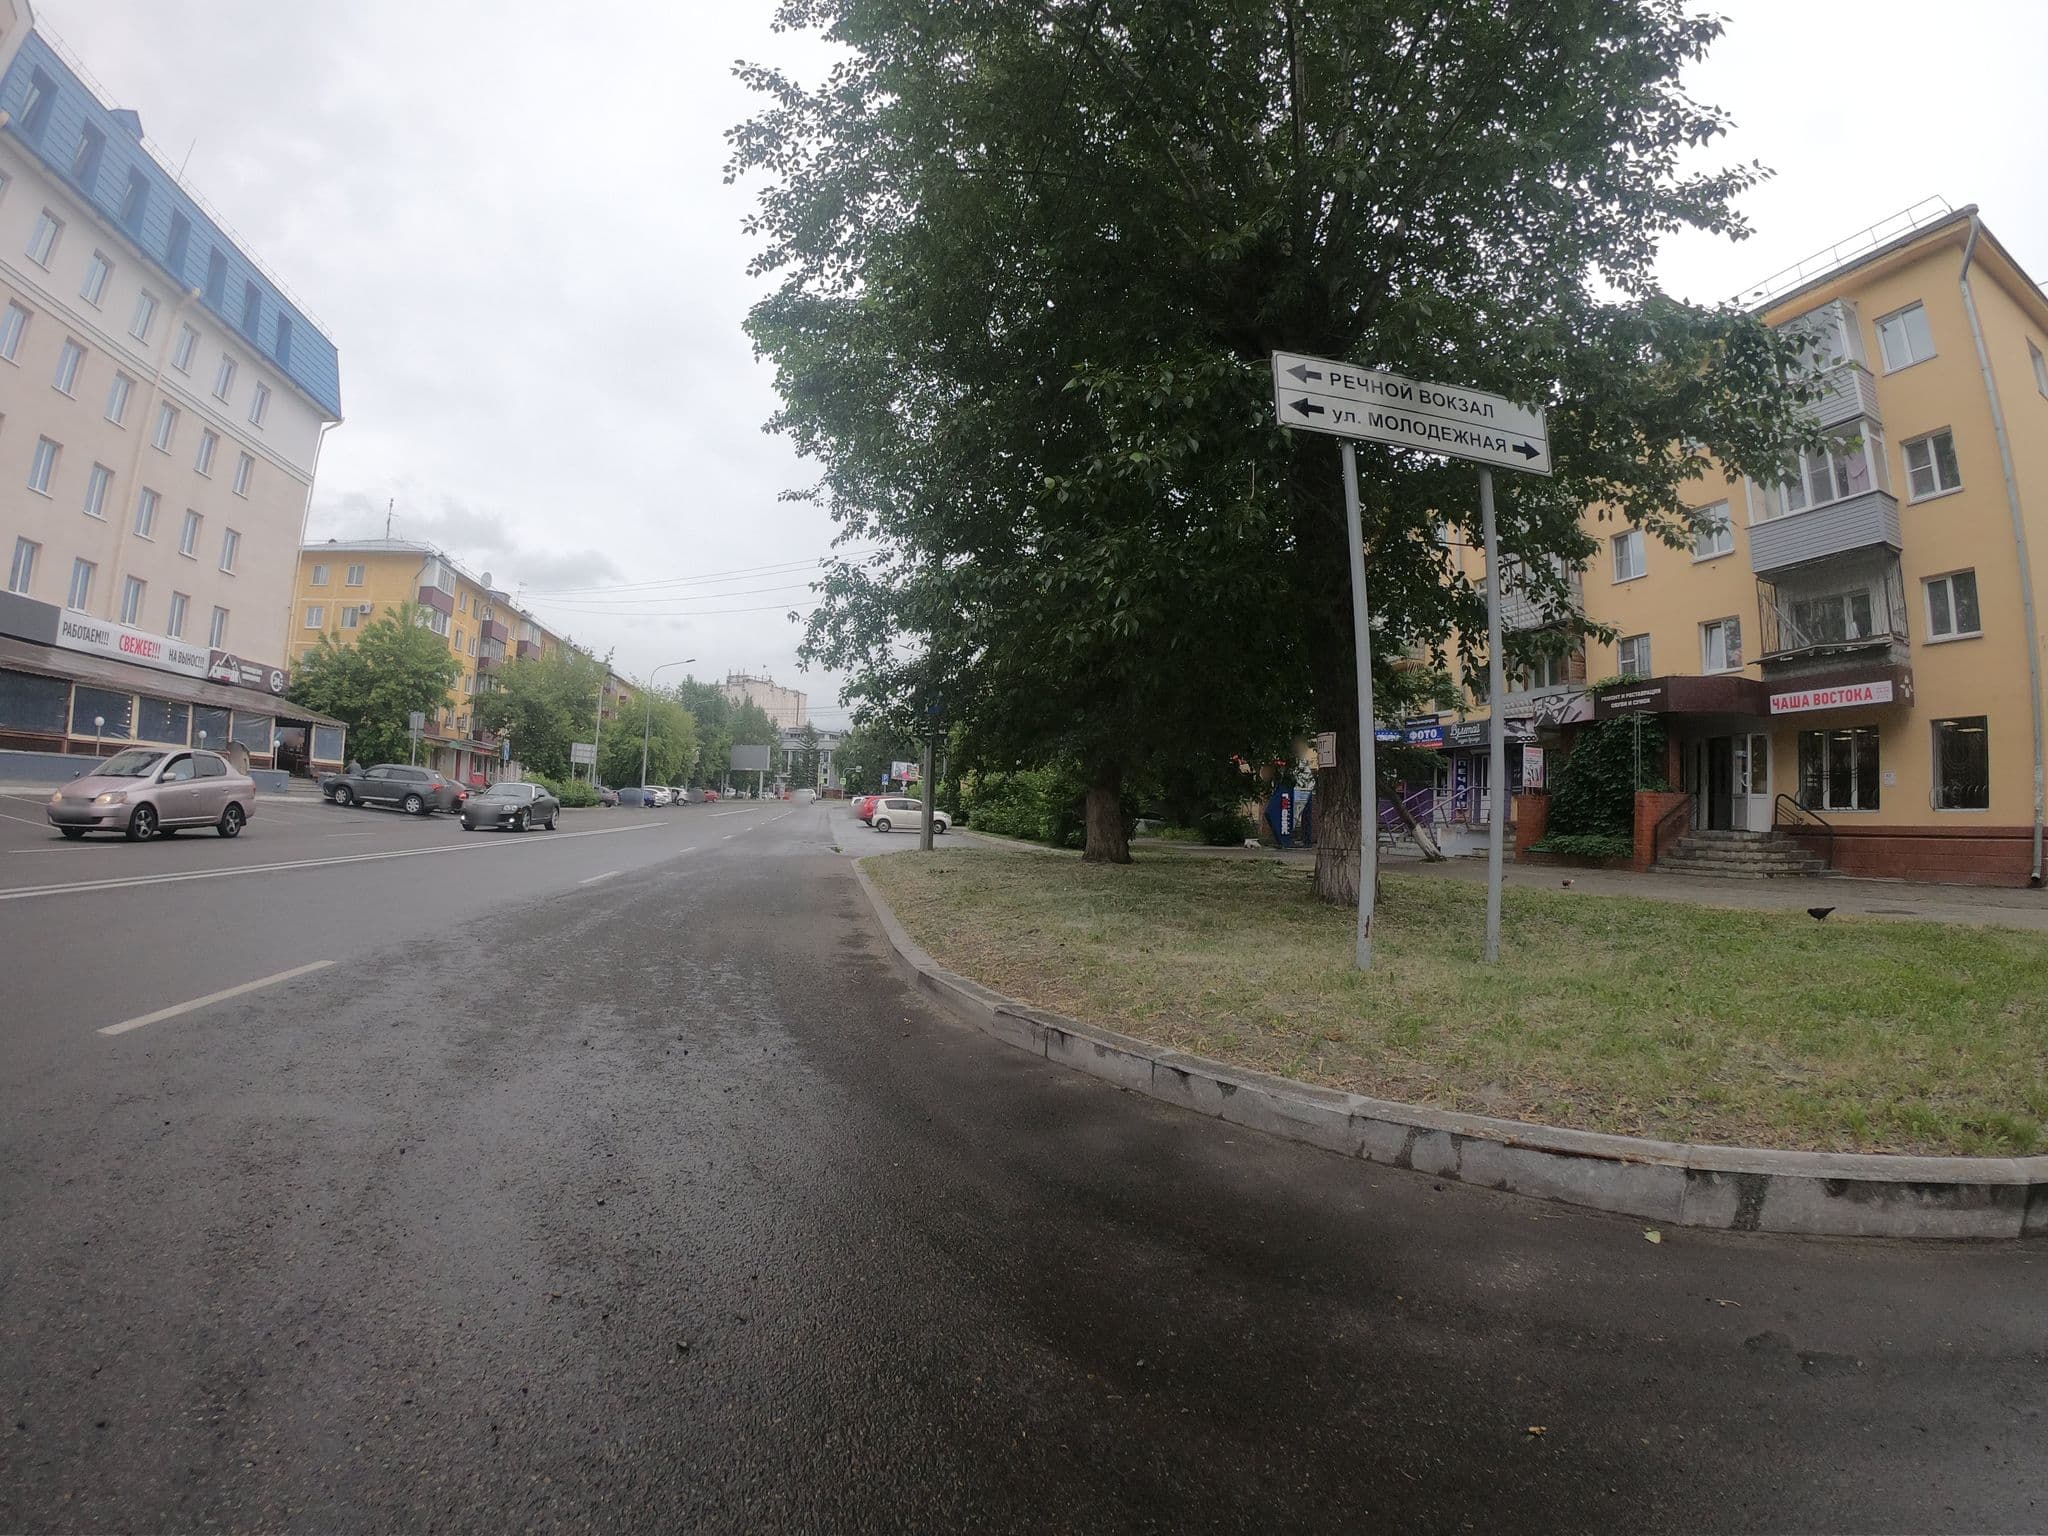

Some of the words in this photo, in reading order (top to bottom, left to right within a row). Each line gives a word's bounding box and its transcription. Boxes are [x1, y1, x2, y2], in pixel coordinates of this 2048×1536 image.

[1330, 373, 1413, 401] РЕЧНОЙ
[1419, 389, 1494, 418] ВОКЗАЛ
[1332, 409, 1361, 424] ул.
[1368, 412, 1507, 453] МОЛОДЕЖНАЯ
[62, 621, 109, 646] РАБОТАЕМ!!!
[119, 634, 161, 660] СВЕЖЕЕ!!!
[1772, 695, 1810, 710] ЧАША
[1813, 687, 1873, 706] ВОСТОКА
[1409, 729, 1437, 740] ФОТО
